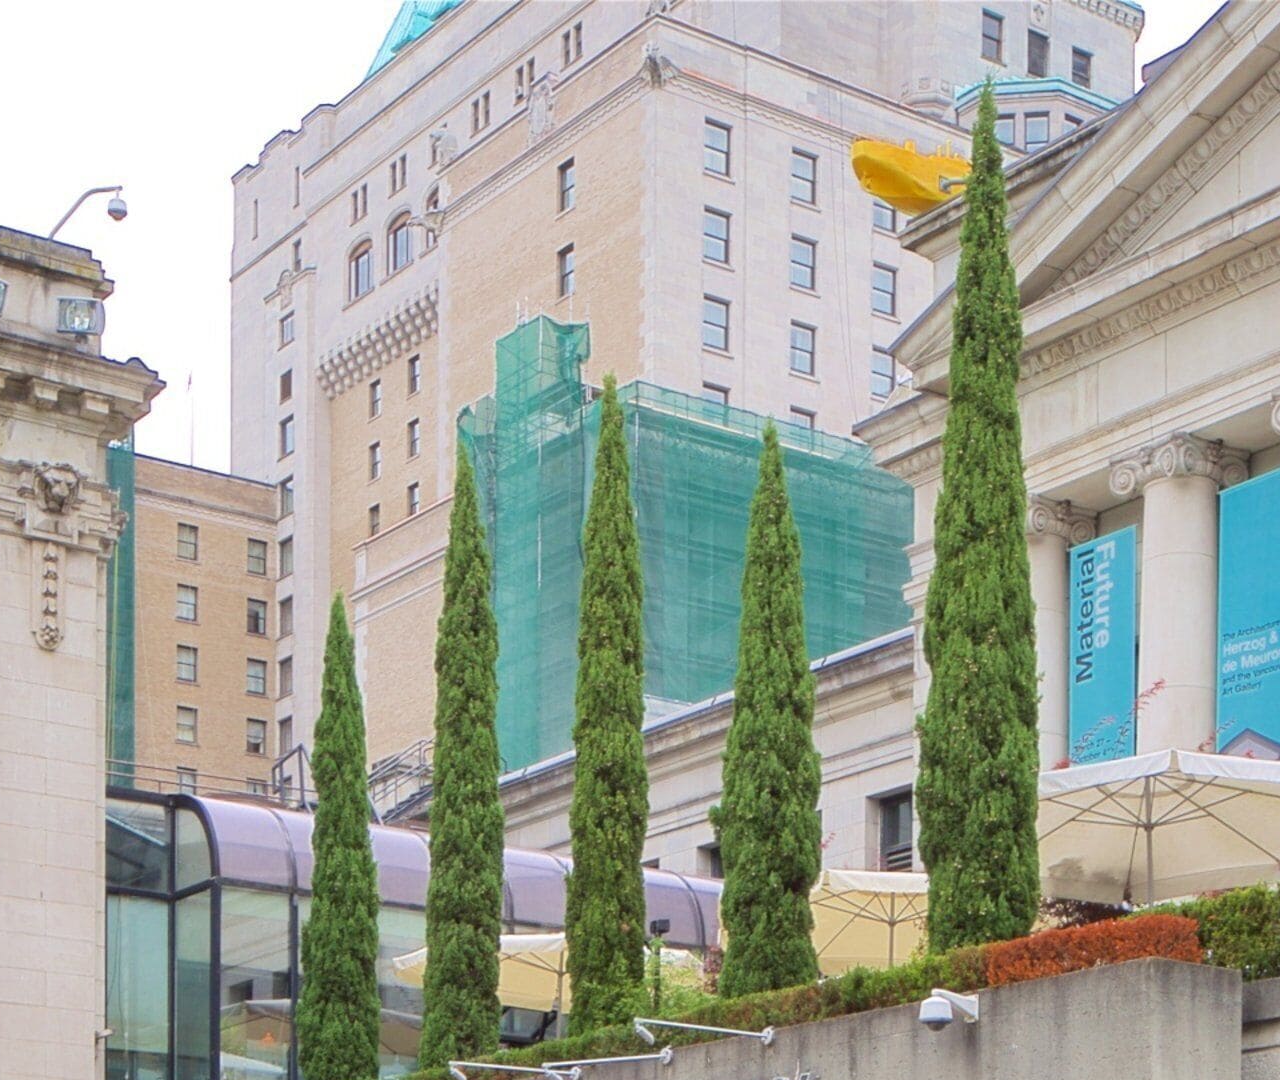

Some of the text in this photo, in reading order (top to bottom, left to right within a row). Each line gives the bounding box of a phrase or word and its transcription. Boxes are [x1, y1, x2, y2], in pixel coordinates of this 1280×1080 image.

[1075, 549, 1094, 683] Material
[1094, 540, 1116, 648] Future
[1222, 660, 1237, 674] de
[1223, 630, 1278, 657] Herzog &
